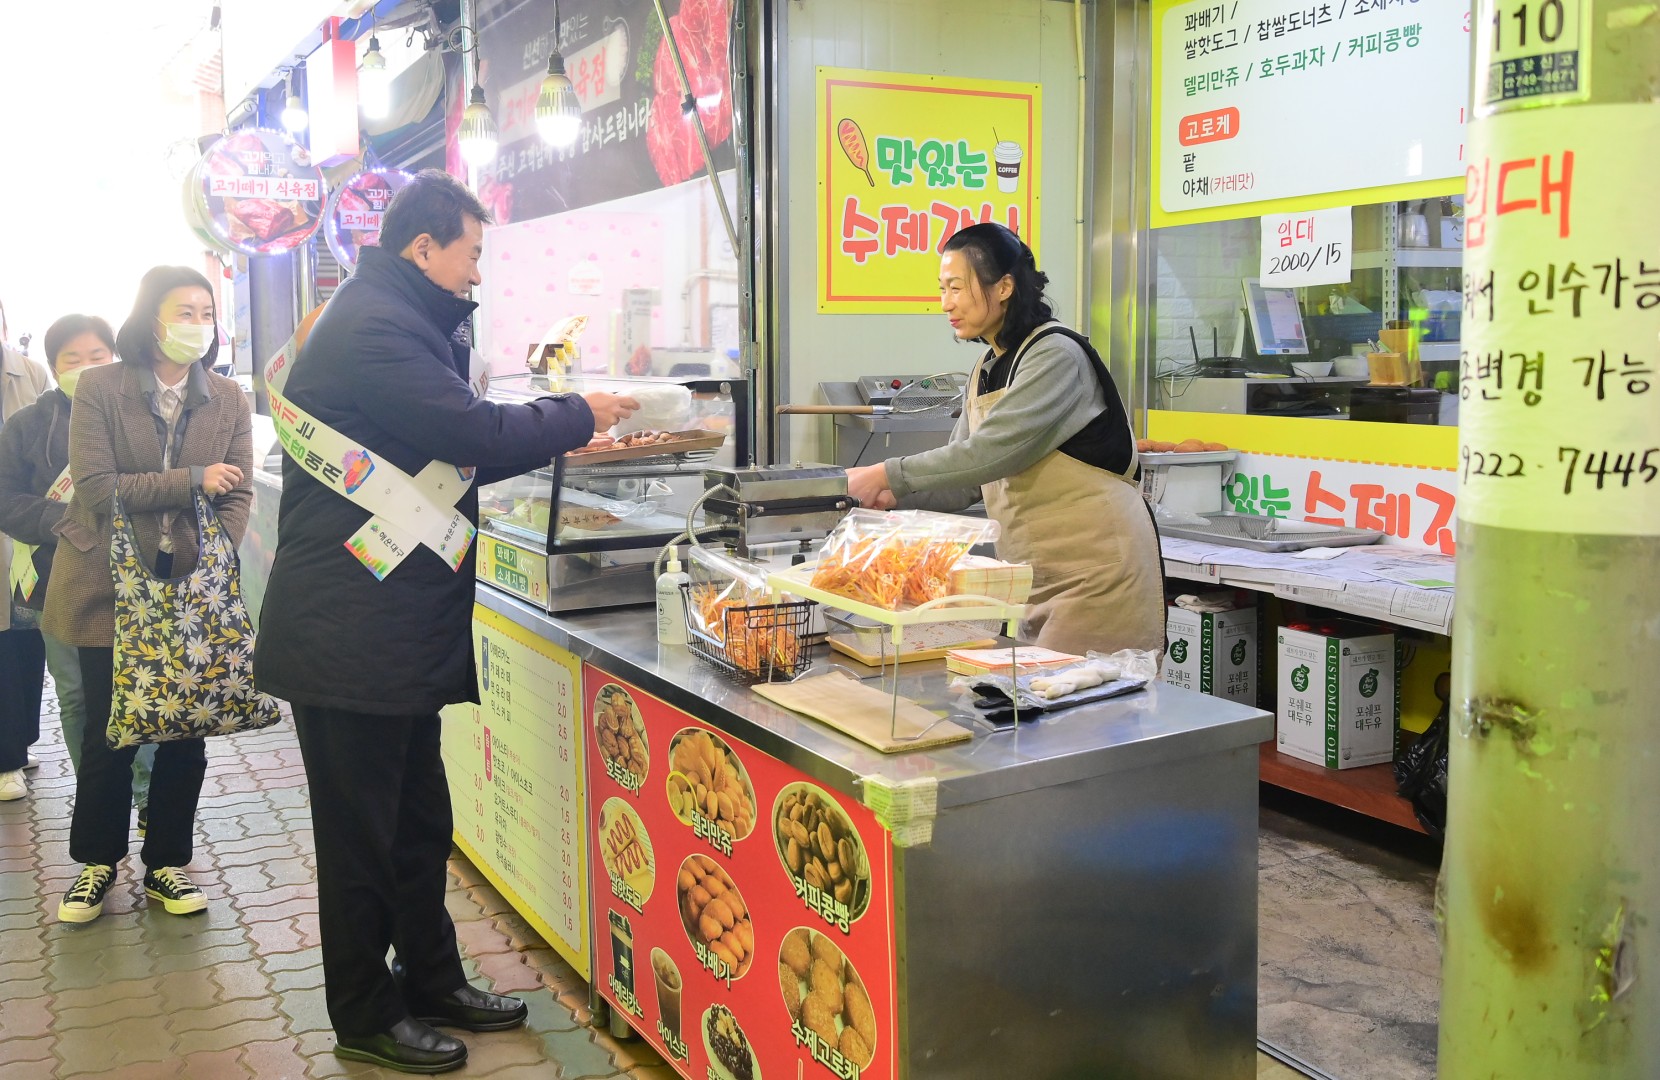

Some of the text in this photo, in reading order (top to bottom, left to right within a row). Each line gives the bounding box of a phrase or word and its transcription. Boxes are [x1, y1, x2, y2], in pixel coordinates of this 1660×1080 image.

[1184, 4, 1225, 32] 꽈배기
[1184, 29, 1239, 60] 쌀핫도그
[1257, 5, 1333, 41] 찹쌀도너츠
[1184, 66, 1240, 97] 델리만쥬
[1259, 45, 1326, 79] 호두과자
[1348, 22, 1423, 58] 커피콩빵
[1185, 114, 1230, 141] 고로케
[876, 137, 988, 188] 맛있는
[997, 166, 1018, 174] COFFEE
[1182, 152, 1197, 173] 팥
[275, 180, 317, 199] 식육점
[1182, 172, 1255, 197] 야채(카레맛)
[1465, 150, 1575, 249] 임대
[1278, 216, 1315, 248] 임대
[1572, 349, 1655, 401] 가능
[443, 513, 460, 543] 해운대구
[379, 530, 405, 558] 해운대구
[1167, 668, 1192, 682] 포쉐프
[1227, 671, 1249, 684] 포쉐프
[1227, 682, 1249, 696] 대두유
[1287, 709, 1313, 727] 대두유
[1288, 697, 1313, 713] 포쉐프
[1326, 644, 1338, 763] CUSTOMIZE OIL
[1355, 703, 1382, 717] 포쉐프
[1355, 716, 1382, 732] 대두유
[606, 756, 640, 798] 호두과자
[691, 808, 733, 858] 델리만쥬
[610, 869, 643, 914] 쌀핫도그
[795, 875, 850, 934] 커피콩빵
[696, 941, 731, 989] 꽈배기
[608, 973, 645, 1019] 아메리카노
[656, 1019, 689, 1065] 아이스티
[791, 1019, 861, 1080] 수제고로케
